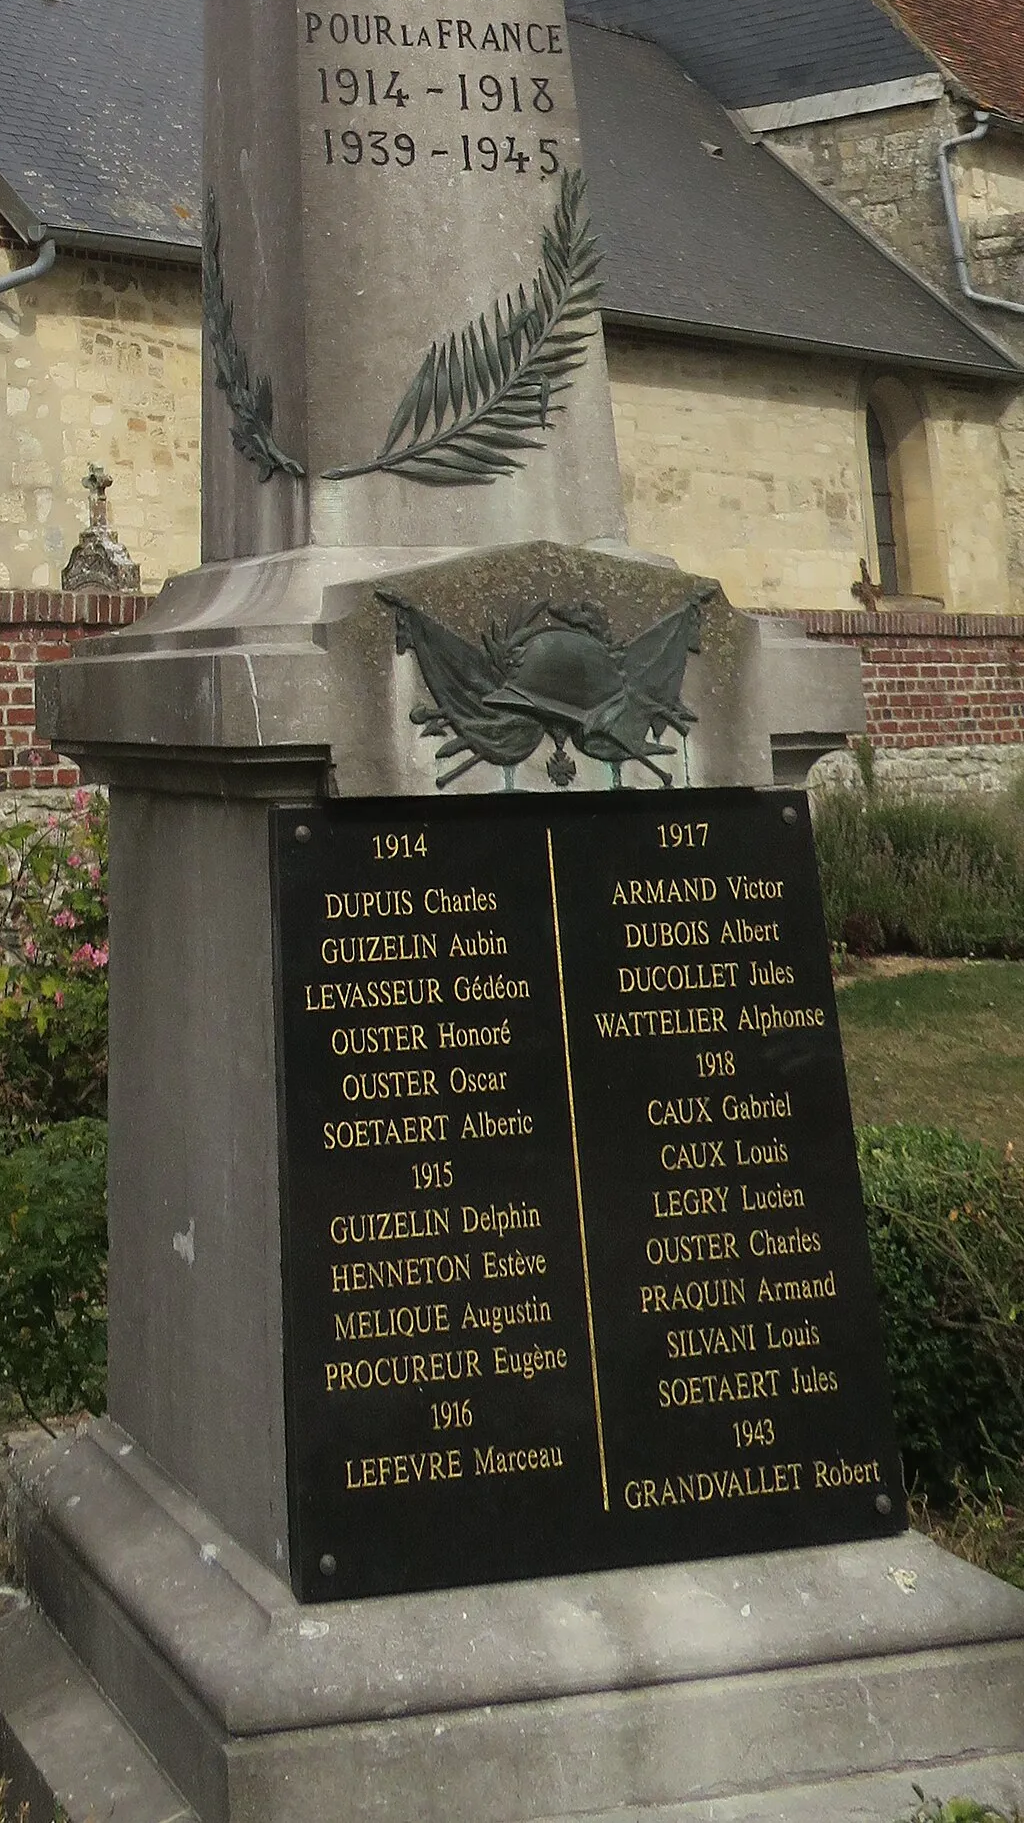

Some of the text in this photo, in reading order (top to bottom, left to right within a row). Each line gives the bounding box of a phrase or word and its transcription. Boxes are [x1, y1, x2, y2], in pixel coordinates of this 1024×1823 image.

[306, 13, 563, 55] POUR LA FRANCE
[319, 68, 410, 107] 1914
[458, 74, 555, 113] 1918
[324, 129, 415, 167] 1939
[461, 134, 559, 175] 1945
[372, 833, 428, 860] 1914
[658, 823, 708, 848] 1917
[325, 887, 497, 919] DUPUIS Charles
[612, 876, 784, 905] ARMAND Victor
[321, 930, 508, 964] GUIZELIN Aubin
[624, 919, 779, 948] DUBOIS Albert
[305, 974, 530, 1011] LEVASSEUR Gédéon
[618, 961, 794, 993] DUCOLLET Jules
[331, 1019, 510, 1055] OUSTER Honoré
[594, 1005, 825, 1038] WATTELIER Alphonse
[696, 1051, 735, 1078] 1918
[342, 1067, 507, 1101] OUSTER Oscar
[647, 1092, 792, 1126] CAUX Gabriel
[324, 1108, 533, 1150] SOETAERT Alberic
[661, 1138, 788, 1171] CAUX Louis
[412, 1162, 453, 1190] 1915
[652, 1183, 805, 1218] LEGRY Lucien
[330, 1202, 541, 1244] GUIZELIN Delphin
[646, 1227, 821, 1265] OUSTER Charles
[331, 1249, 547, 1293] HENNETON Estève
[640, 1272, 837, 1313] PRAQUIN Armand
[334, 1296, 552, 1341] MELIQUE Augustin
[667, 1319, 820, 1359] SILVANI Louis
[324, 1344, 568, 1392] PROCUREUR Eugène
[659, 1366, 838, 1408] SOETAERT Jules
[430, 1399, 473, 1430] 1916
[732, 1420, 775, 1448] 1943
[345, 1445, 563, 1489] LEFEVRE Marceau
[625, 1461, 881, 1510] GRANDVALLET Robert
